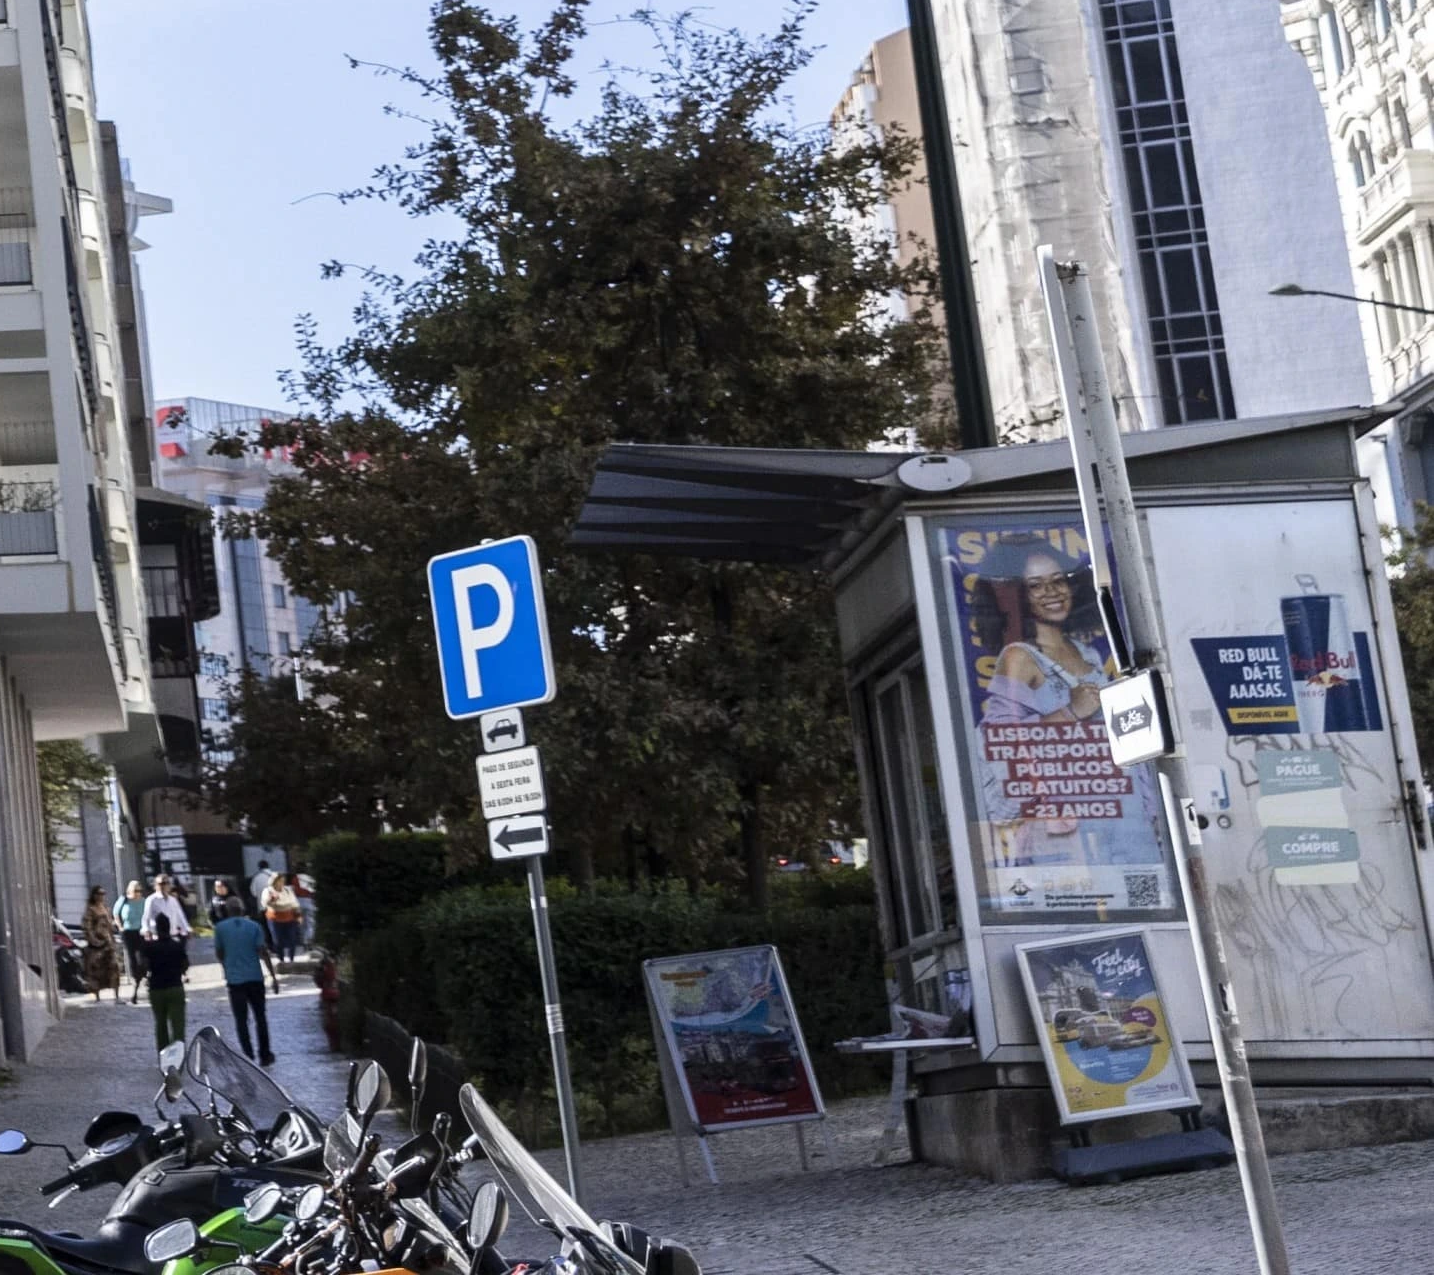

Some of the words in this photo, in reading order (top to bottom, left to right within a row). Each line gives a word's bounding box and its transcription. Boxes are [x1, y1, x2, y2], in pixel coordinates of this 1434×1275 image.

[450, 562, 516, 700] P
[1218, 649, 1245, 664] RED
[1247, 647, 1280, 662] BULL
[1242, 662, 1283, 681] DÁ-TE
[1229, 683, 1288, 699] AAASAS.
[987, 726, 1059, 742] LISBOA
[1063, 722, 1087, 740] JÁ
[988, 742, 1111, 761] TRANSPORT
[1015, 759, 1113, 777] PÚBLICOS
[1275, 763, 1322, 776] PAGUE
[1006, 778, 1128, 796] GRATUITOS?
[1025, 804, 1058, 819] -23
[1061, 802, 1118, 818] ANOS
[1281, 841, 1340, 855] COMPRE
[1091, 947, 1124, 975] Feel
